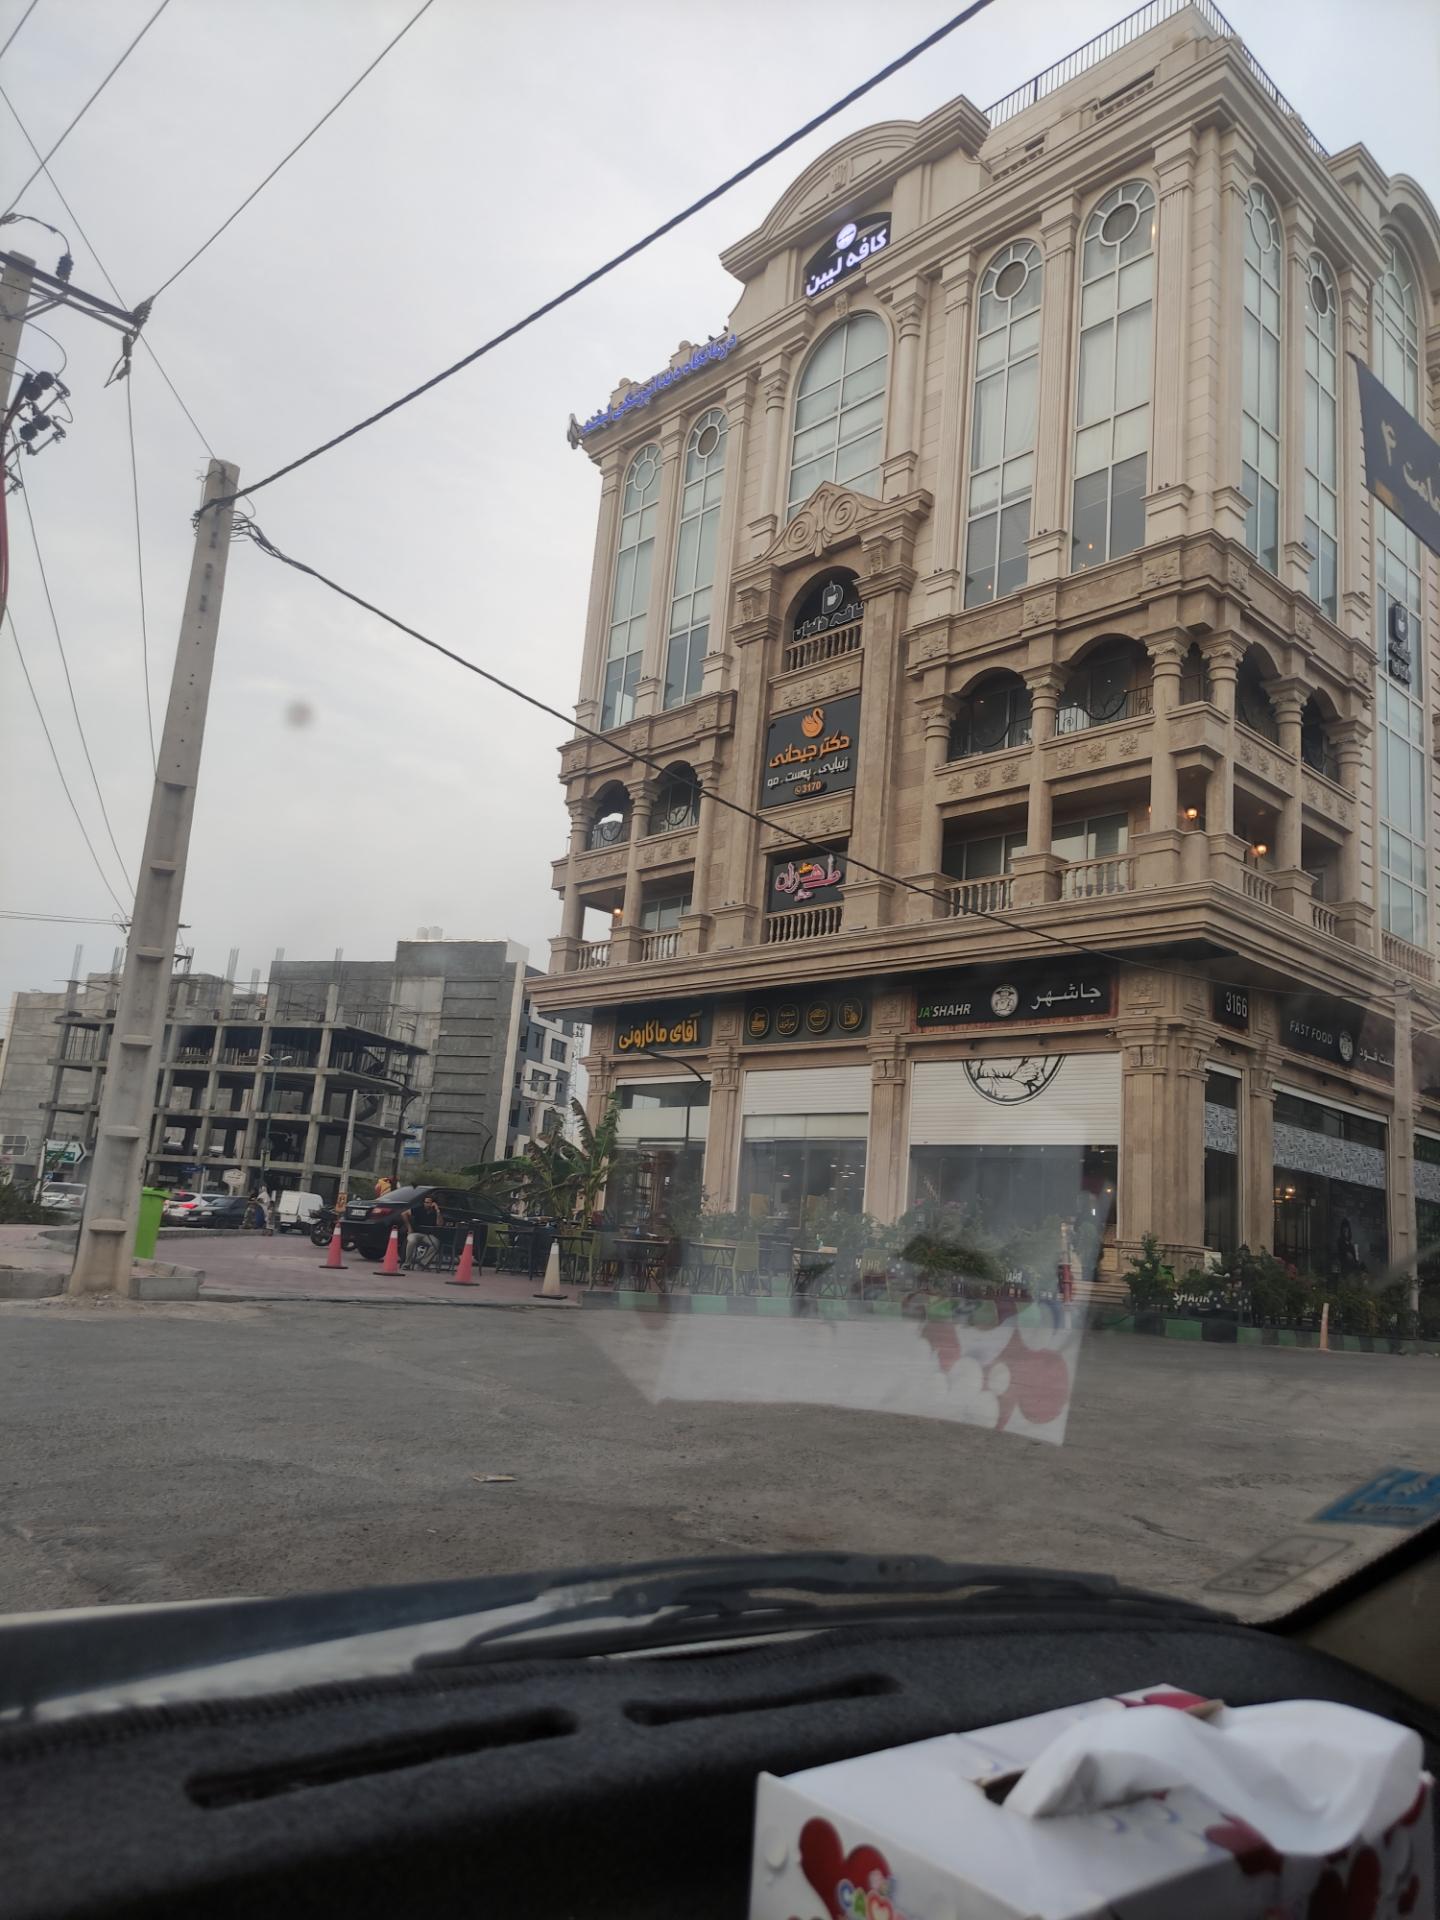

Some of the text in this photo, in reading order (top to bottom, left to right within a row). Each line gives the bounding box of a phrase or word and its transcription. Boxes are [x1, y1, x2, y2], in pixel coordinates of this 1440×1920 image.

[846, 229, 886, 267] کافه
[818, 729, 850, 758] دکتر
[818, 756, 849, 773] زیبایی
[802, 781, 822, 793] 3170
[1030, 982, 1102, 1010] جاشهر
[1225, 991, 1248, 1018] 3166
[619, 1009, 703, 1049] آقای ماکارونی
[1289, 1020, 1333, 1045] FAST FOOD
